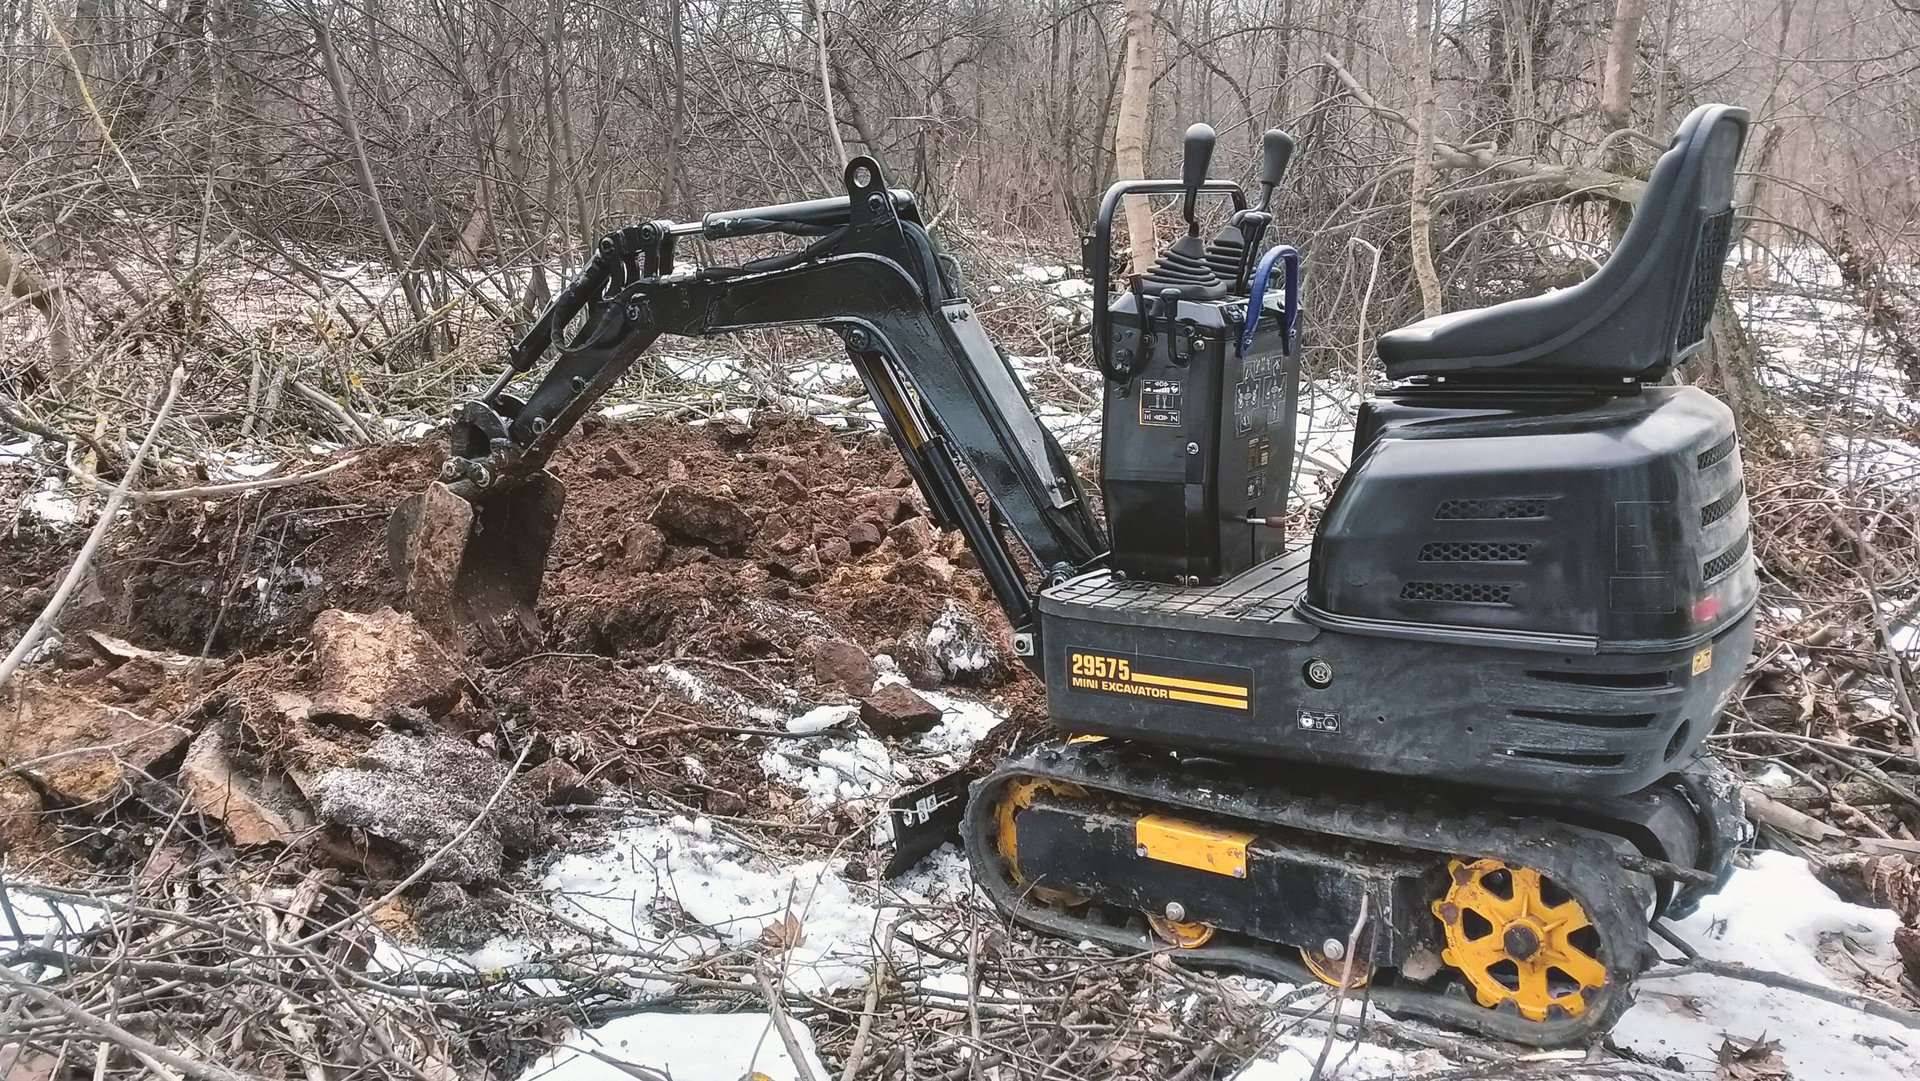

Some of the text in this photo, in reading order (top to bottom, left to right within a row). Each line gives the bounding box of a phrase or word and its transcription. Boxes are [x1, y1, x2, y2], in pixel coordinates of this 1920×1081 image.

[1072, 653, 1130, 681] 29575
[1072, 677, 1168, 699] MINI EXCAVATOR
